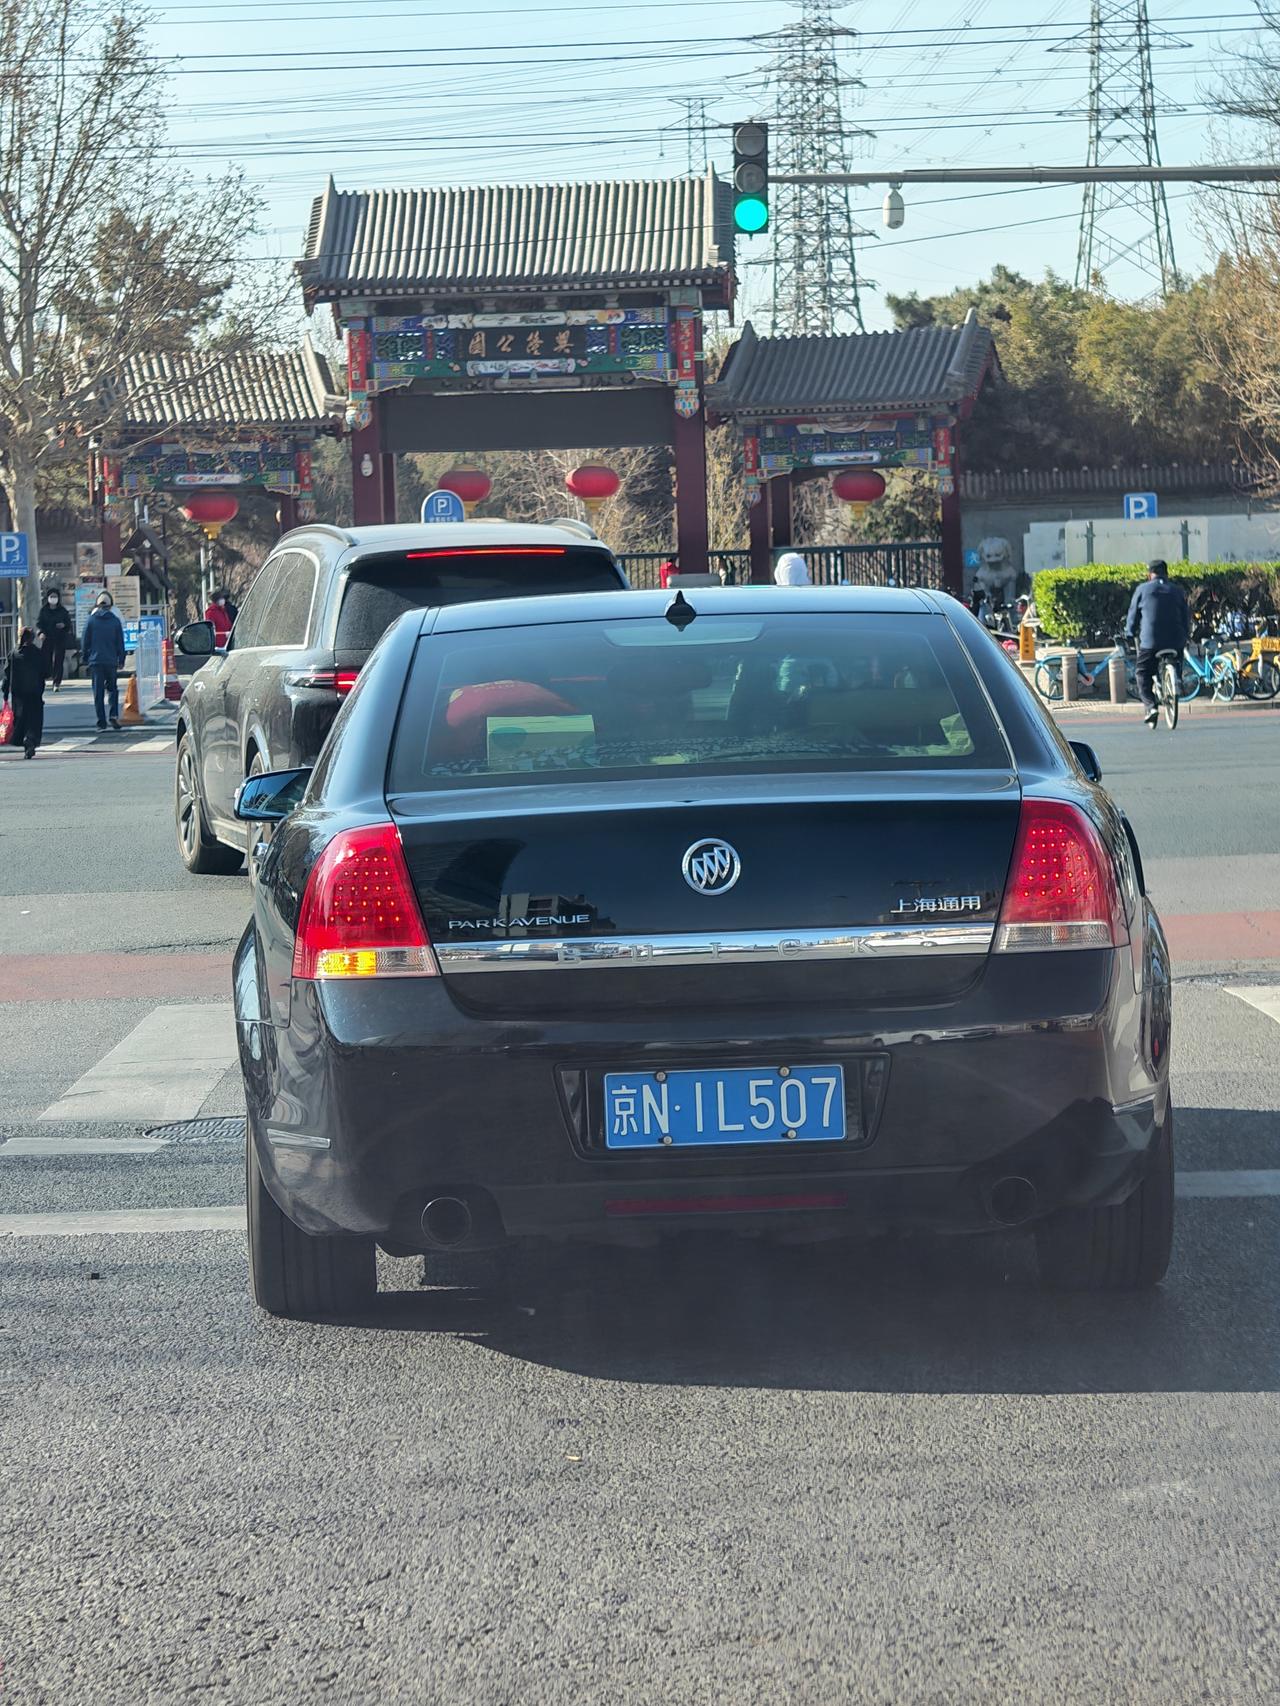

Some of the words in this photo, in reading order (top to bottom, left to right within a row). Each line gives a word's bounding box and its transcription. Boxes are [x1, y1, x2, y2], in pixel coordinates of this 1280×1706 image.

[437, 499, 448, 513] P
[1130, 497, 1148, 520] P
[1, 535, 20, 562] P
[890, 896, 981, 913] 上海通用
